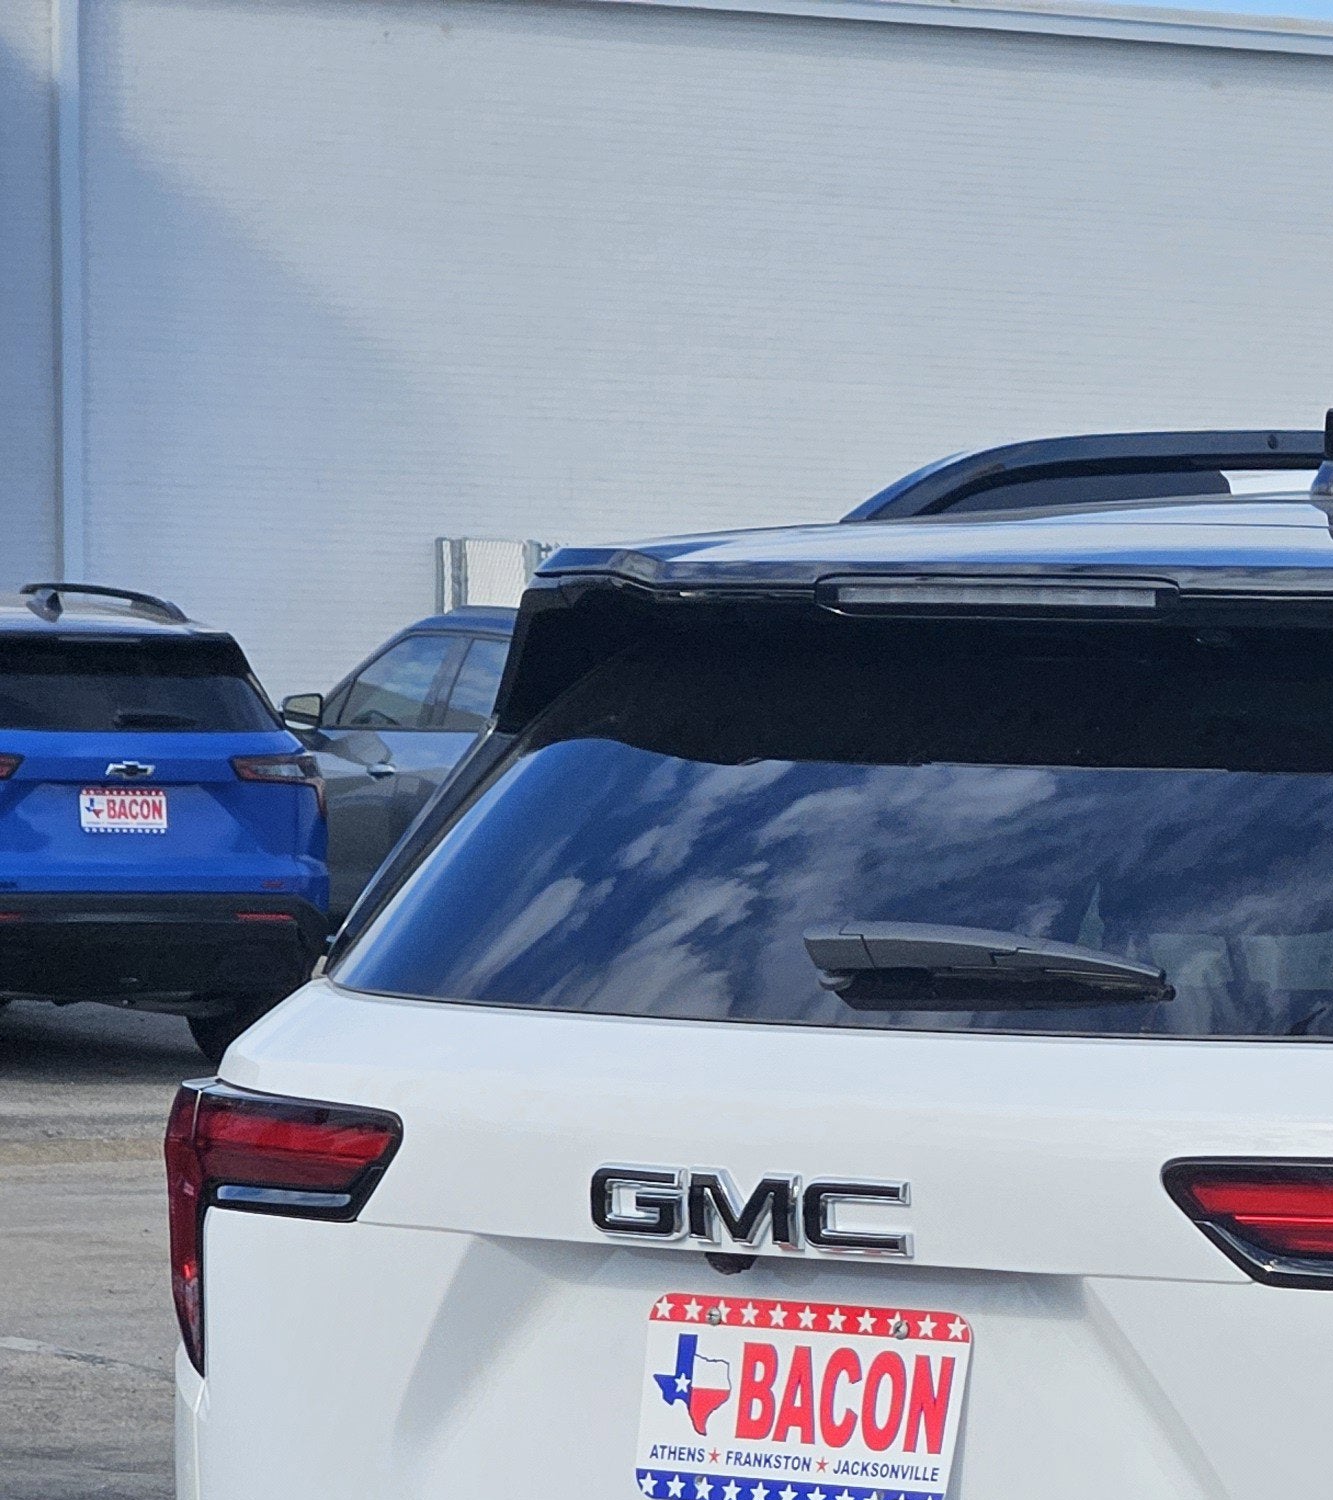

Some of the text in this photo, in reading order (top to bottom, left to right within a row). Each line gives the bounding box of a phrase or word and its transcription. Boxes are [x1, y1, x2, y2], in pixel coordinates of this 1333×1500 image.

[107, 799, 163, 820] BACON
[590, 1162, 914, 1258] GMC
[735, 1341, 956, 1455] BACON
[649, 1444, 940, 1483] ATHENS FRANKSTON JACKSONVILLE
